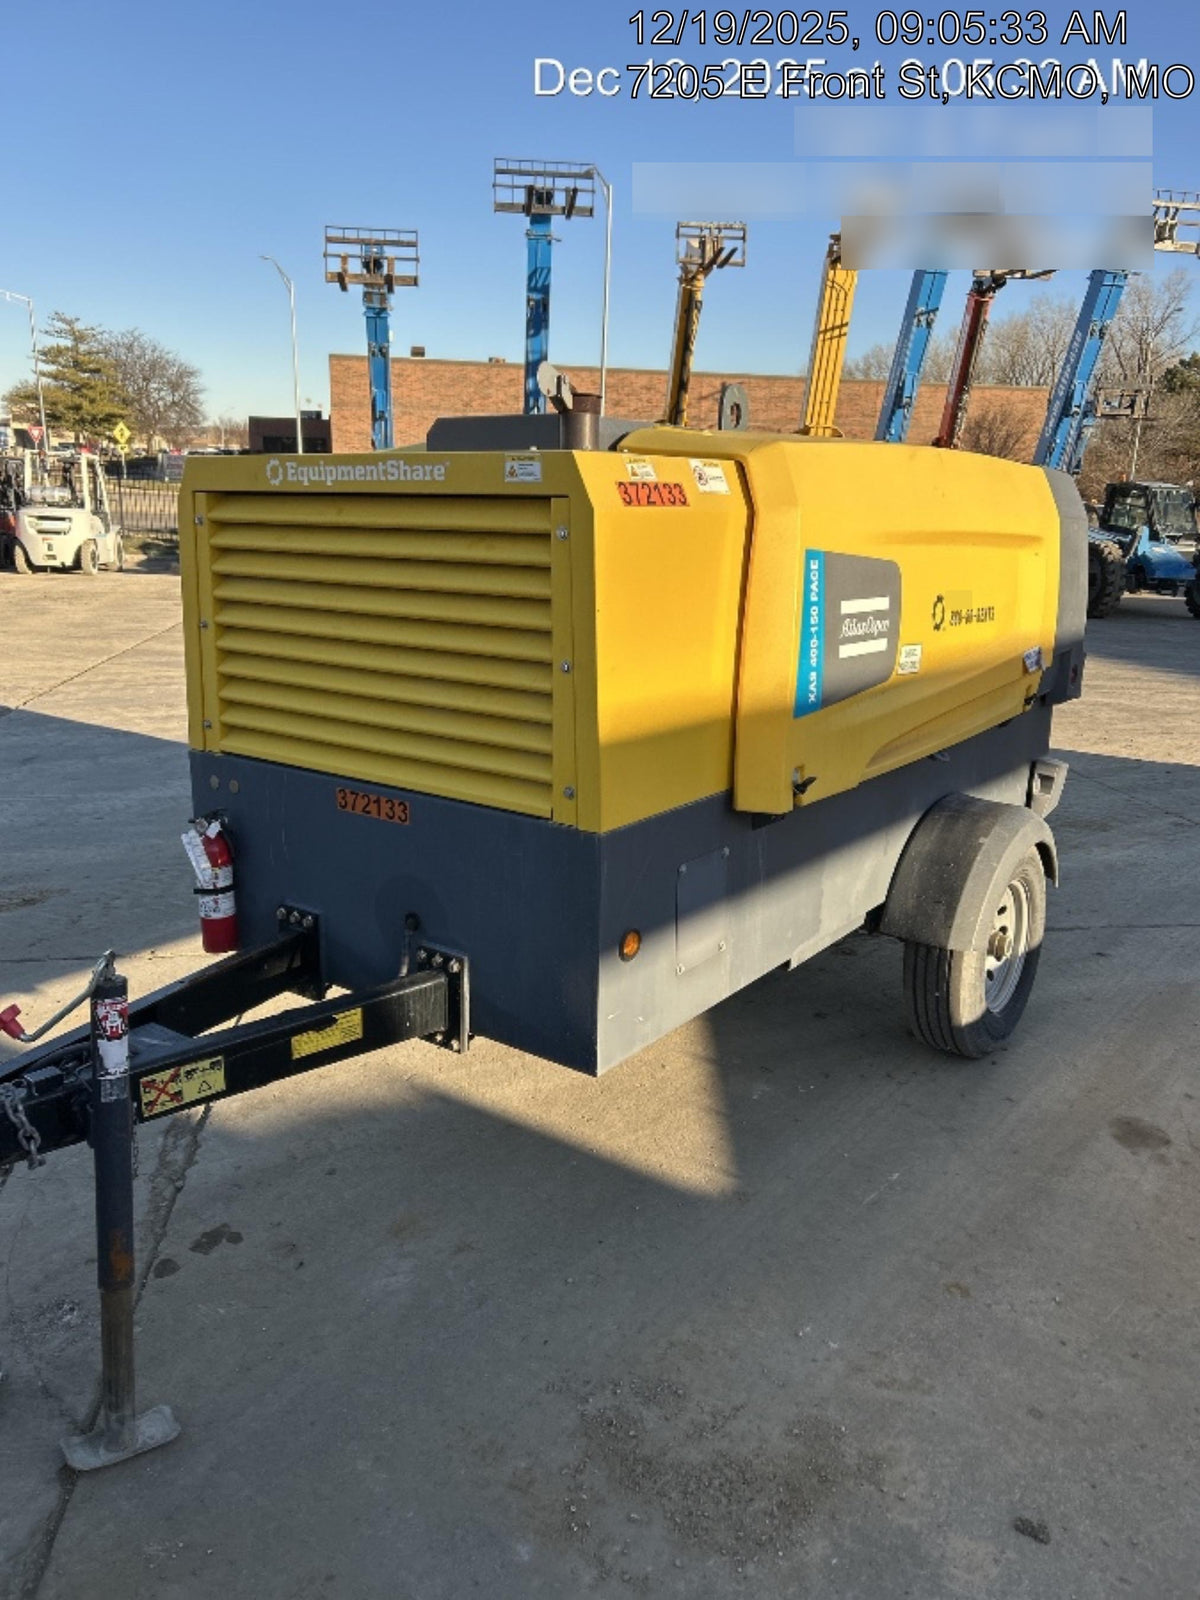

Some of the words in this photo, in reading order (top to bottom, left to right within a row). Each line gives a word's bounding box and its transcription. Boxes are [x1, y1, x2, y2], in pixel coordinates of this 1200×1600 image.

[286, 460, 447, 486] EquipmentShare
[618, 481, 688, 506] 372133
[338, 788, 409, 823] 372133
